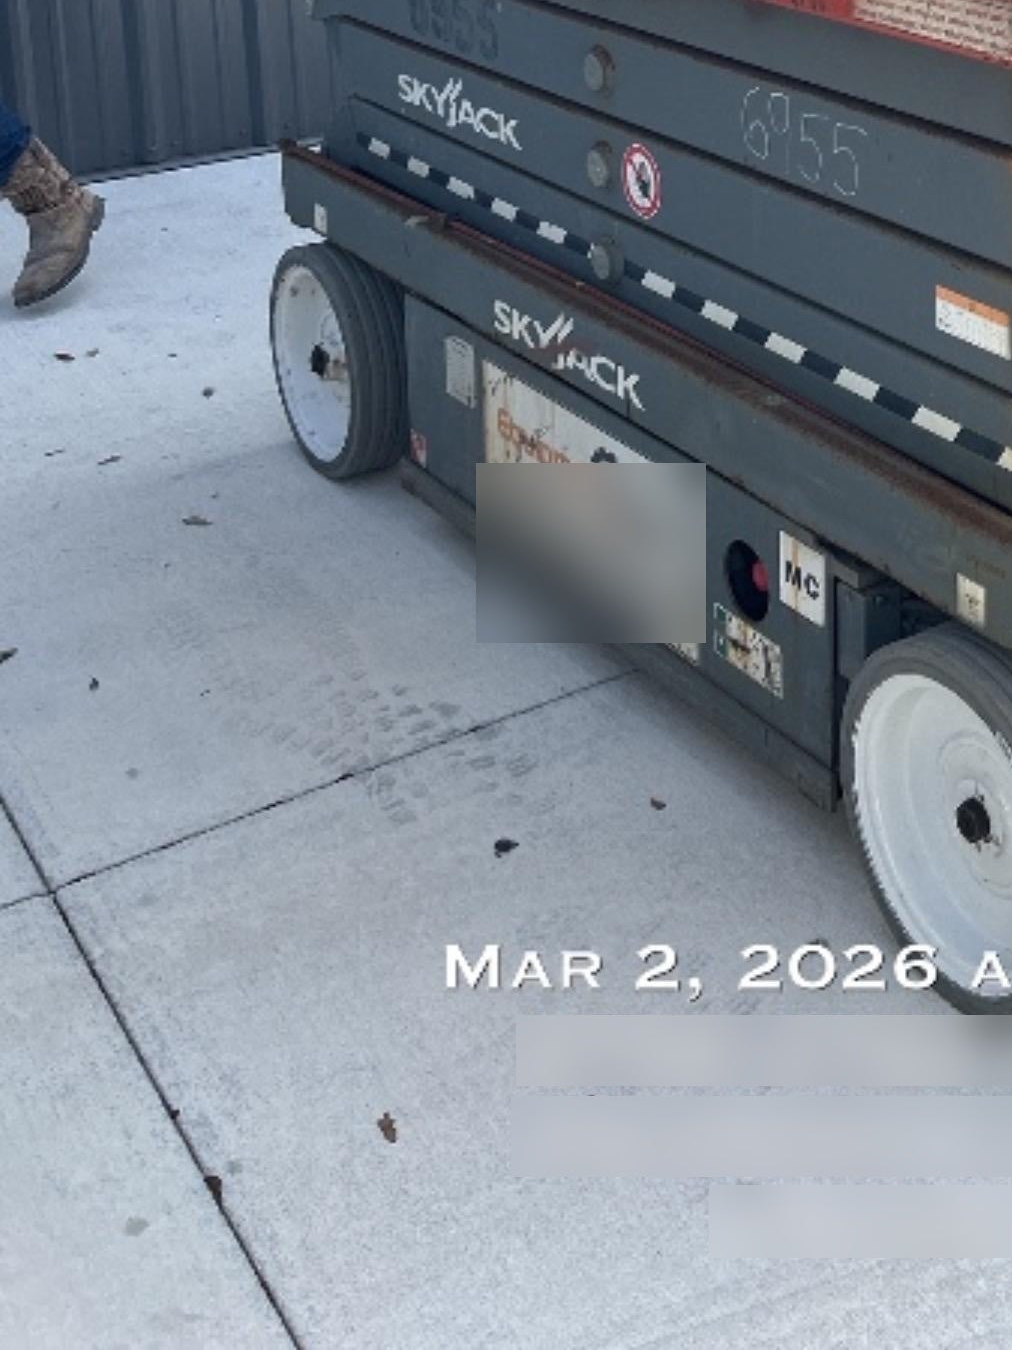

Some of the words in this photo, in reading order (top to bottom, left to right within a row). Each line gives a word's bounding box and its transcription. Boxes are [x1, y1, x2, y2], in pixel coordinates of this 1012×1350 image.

[397, 73, 523, 151] SKYJACK
[741, 86, 868, 197] 6955
[785, 560, 820, 601] MC
